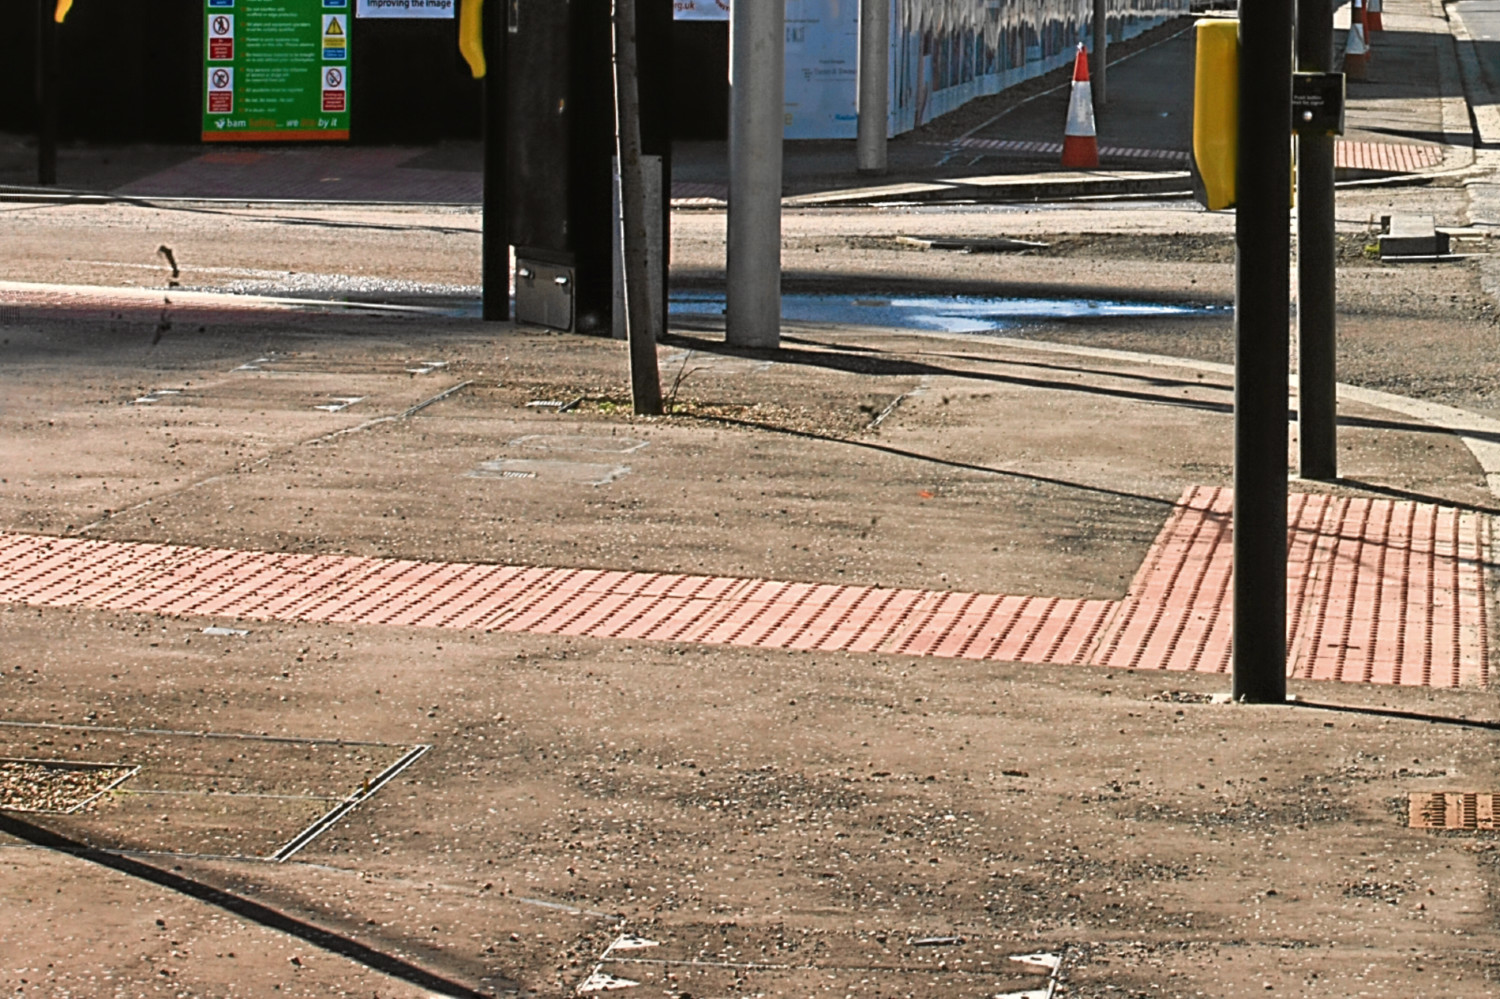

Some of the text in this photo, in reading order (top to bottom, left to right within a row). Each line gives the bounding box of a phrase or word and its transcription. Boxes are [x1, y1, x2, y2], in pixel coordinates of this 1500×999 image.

[412, 0, 424, 7] the
[426, 0, 451, 9] image
[227, 118, 246, 128] bam
[318, 118, 330, 129] by
[331, 118, 337, 127] it
